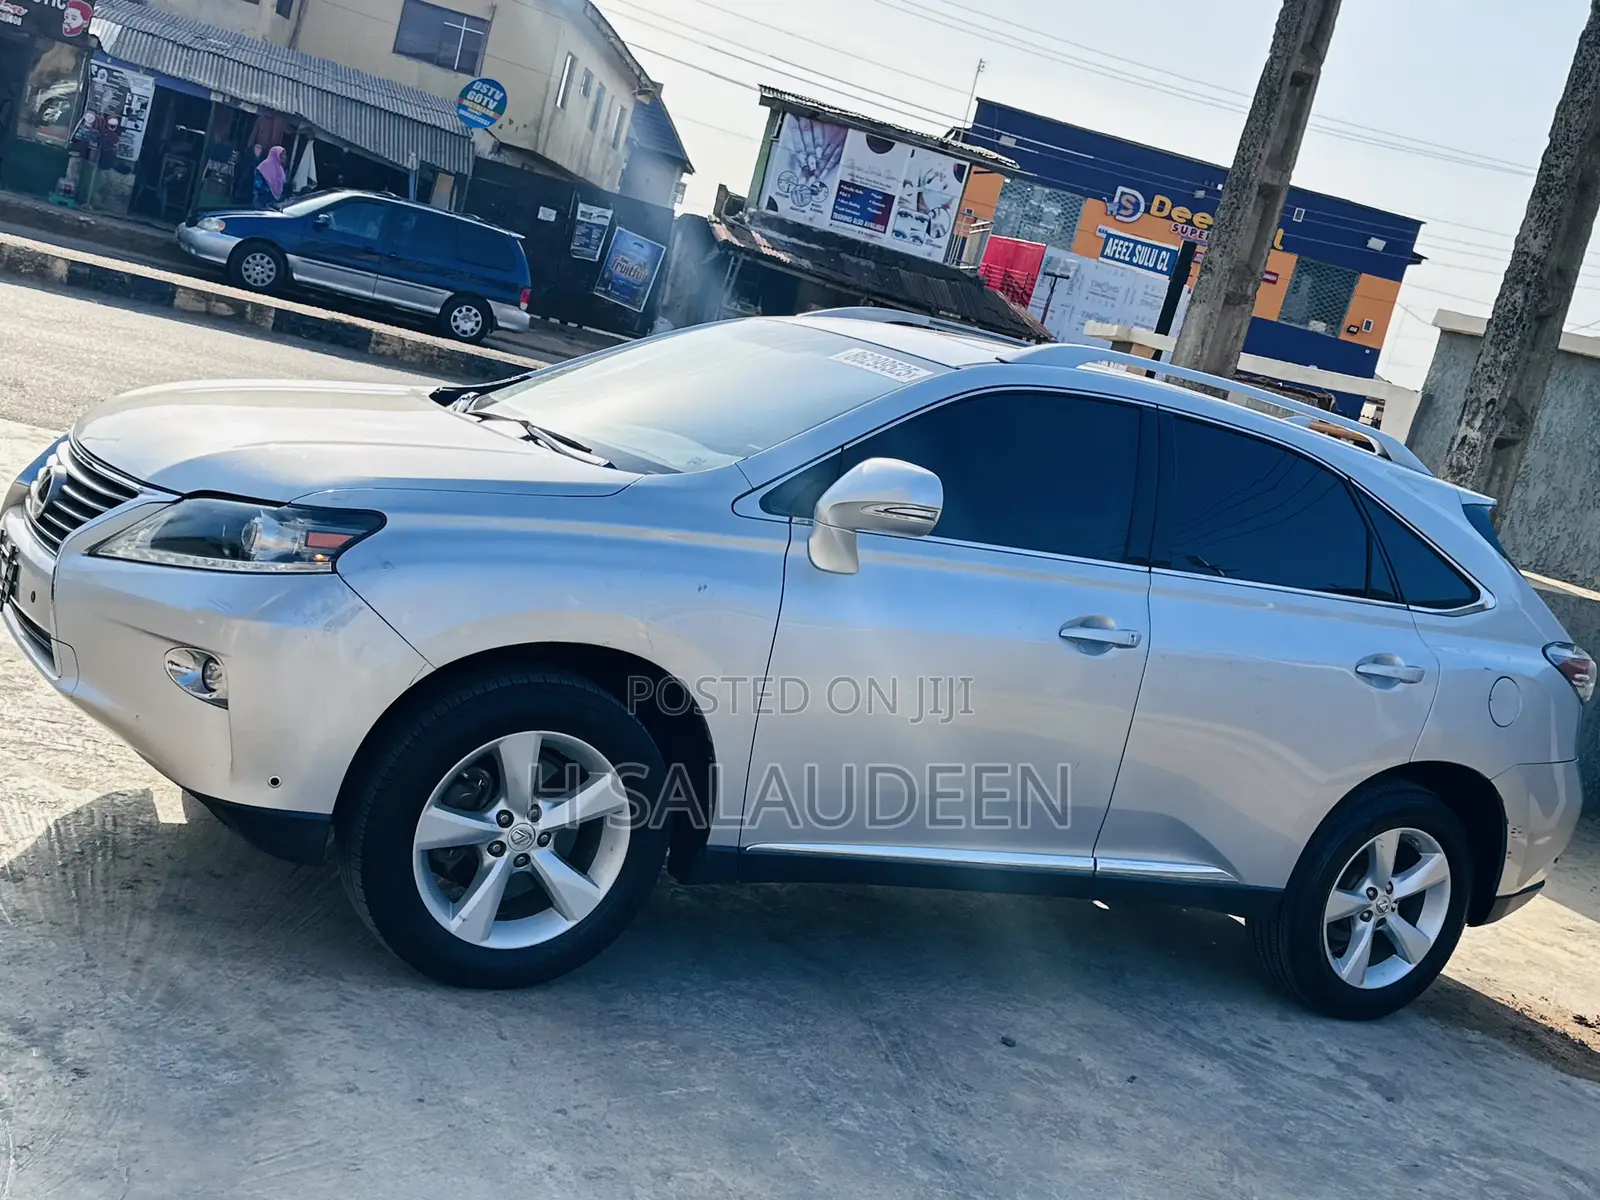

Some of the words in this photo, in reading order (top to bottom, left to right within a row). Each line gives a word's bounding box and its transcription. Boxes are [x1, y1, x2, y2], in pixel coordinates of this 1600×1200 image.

[466, 90, 498, 110] GOTV
[472, 80, 504, 101] DSTV
[1104, 238, 1134, 262] AFEEZ
[1132, 244, 1159, 268] SULU
[1156, 250, 1171, 272] CL
